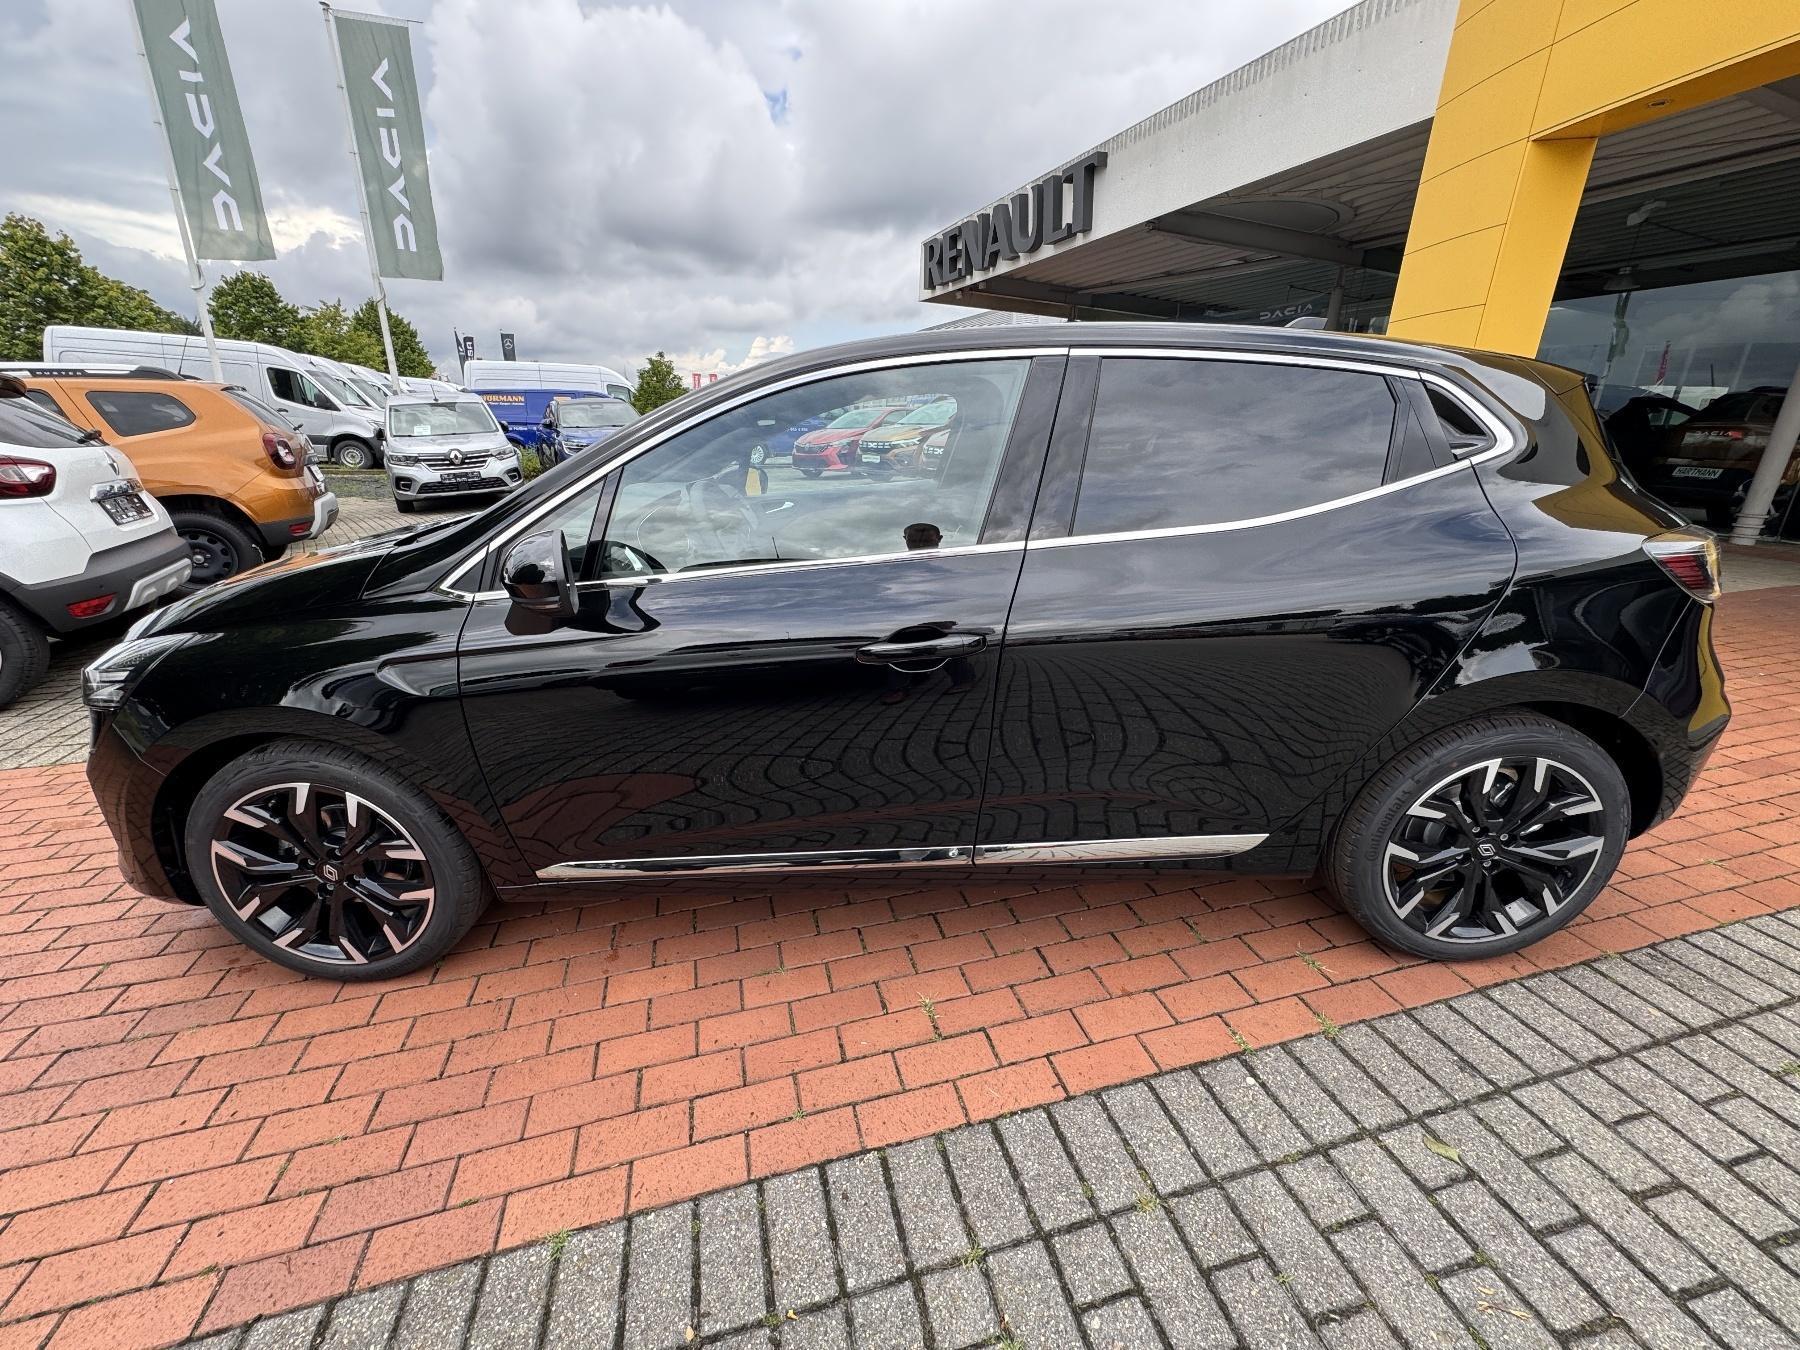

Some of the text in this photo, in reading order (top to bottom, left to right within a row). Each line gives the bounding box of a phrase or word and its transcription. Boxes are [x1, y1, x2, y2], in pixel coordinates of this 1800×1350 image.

[169, 15, 244, 232] DACIA
[371, 57, 417, 252] DACIA
[922, 150, 1108, 291] RENAULT
[1259, 303, 1313, 320] DACIA
